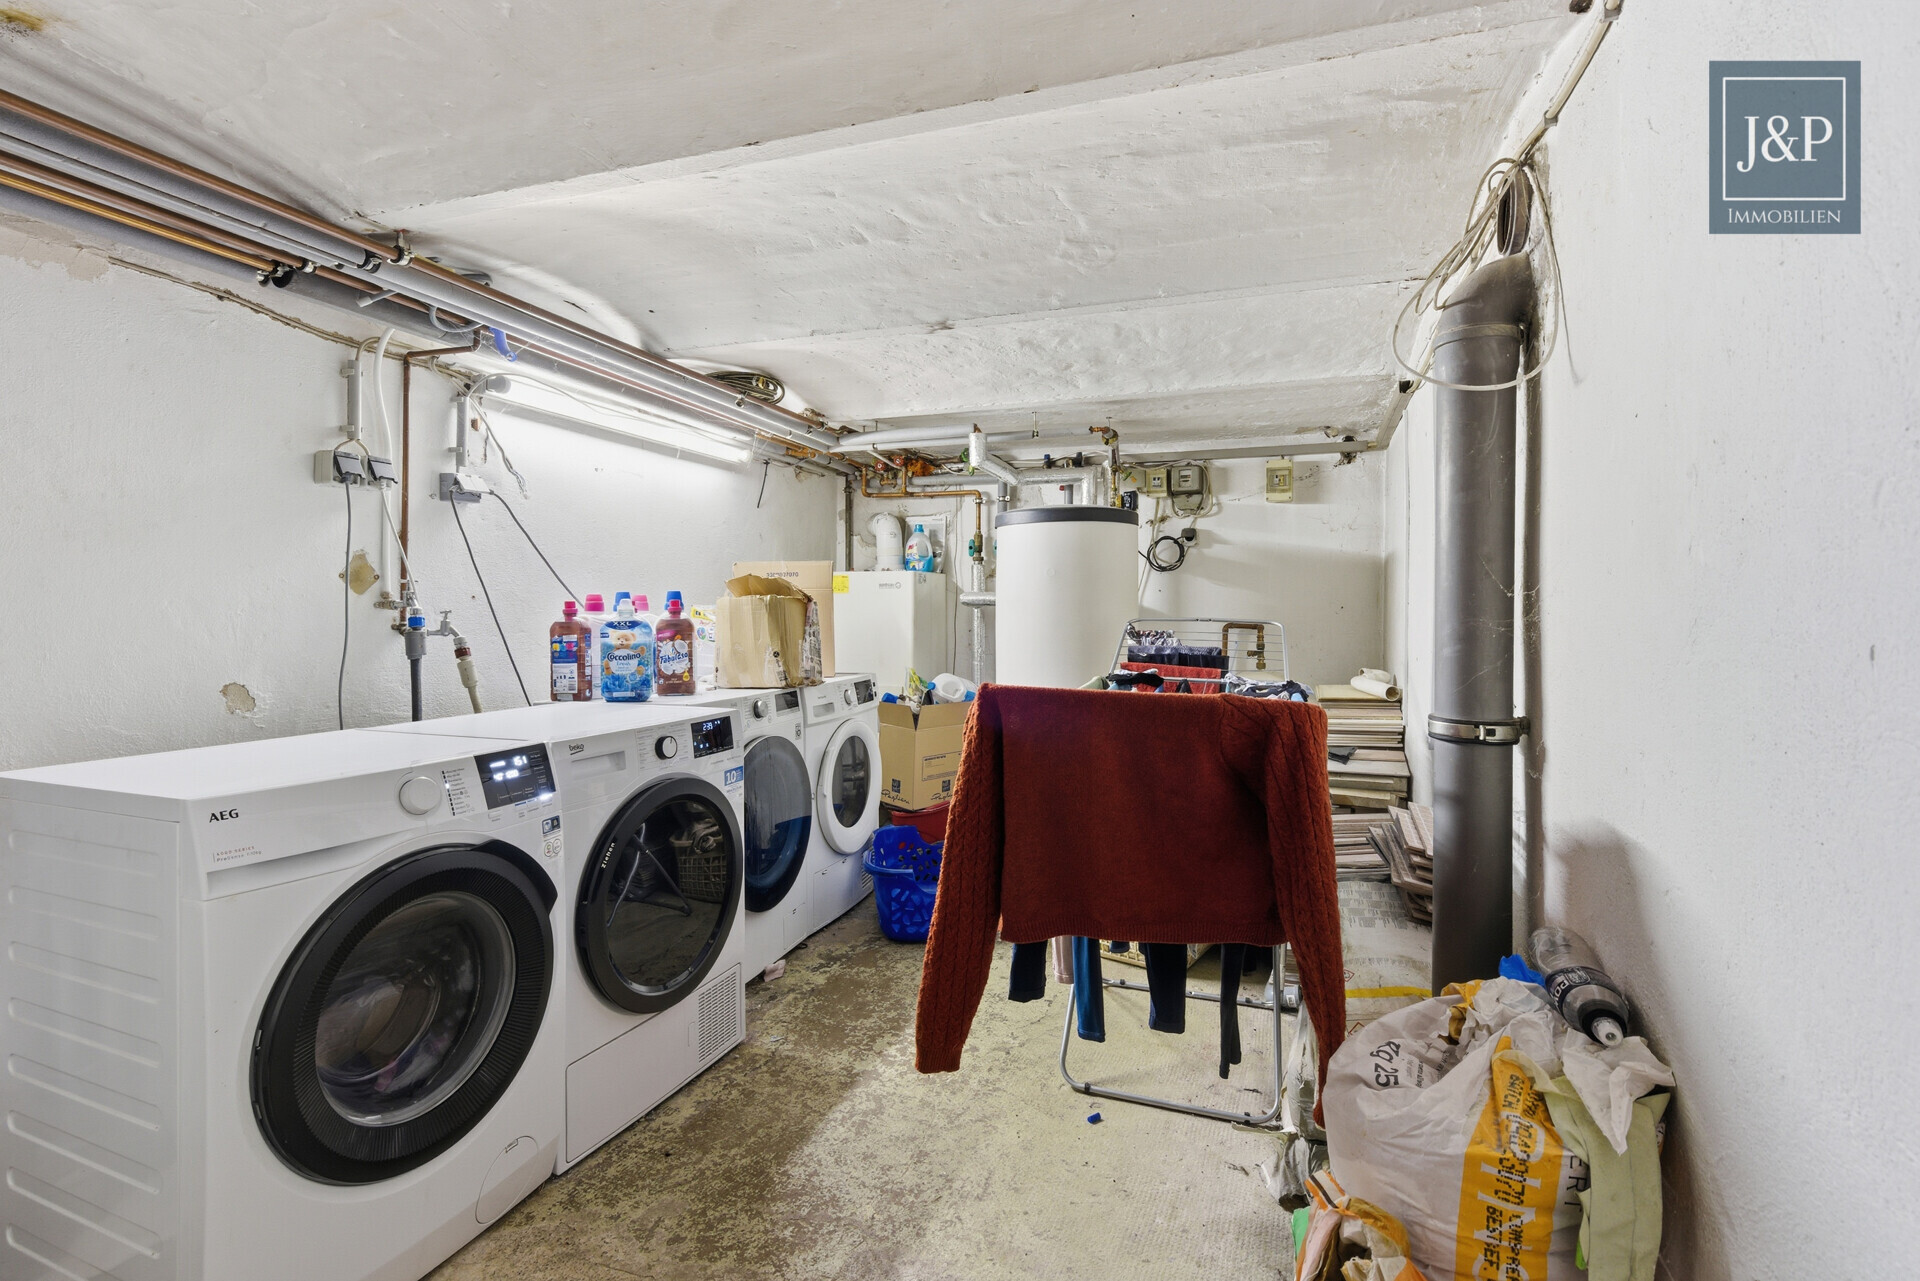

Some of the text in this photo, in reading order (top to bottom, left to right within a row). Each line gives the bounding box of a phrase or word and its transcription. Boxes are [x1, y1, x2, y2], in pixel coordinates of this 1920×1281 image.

[607, 652, 641, 662] Coccolino
[725, 770, 737, 785] 10
[209, 808, 240, 824] AEG
[1374, 1063, 1400, 1088] 25
